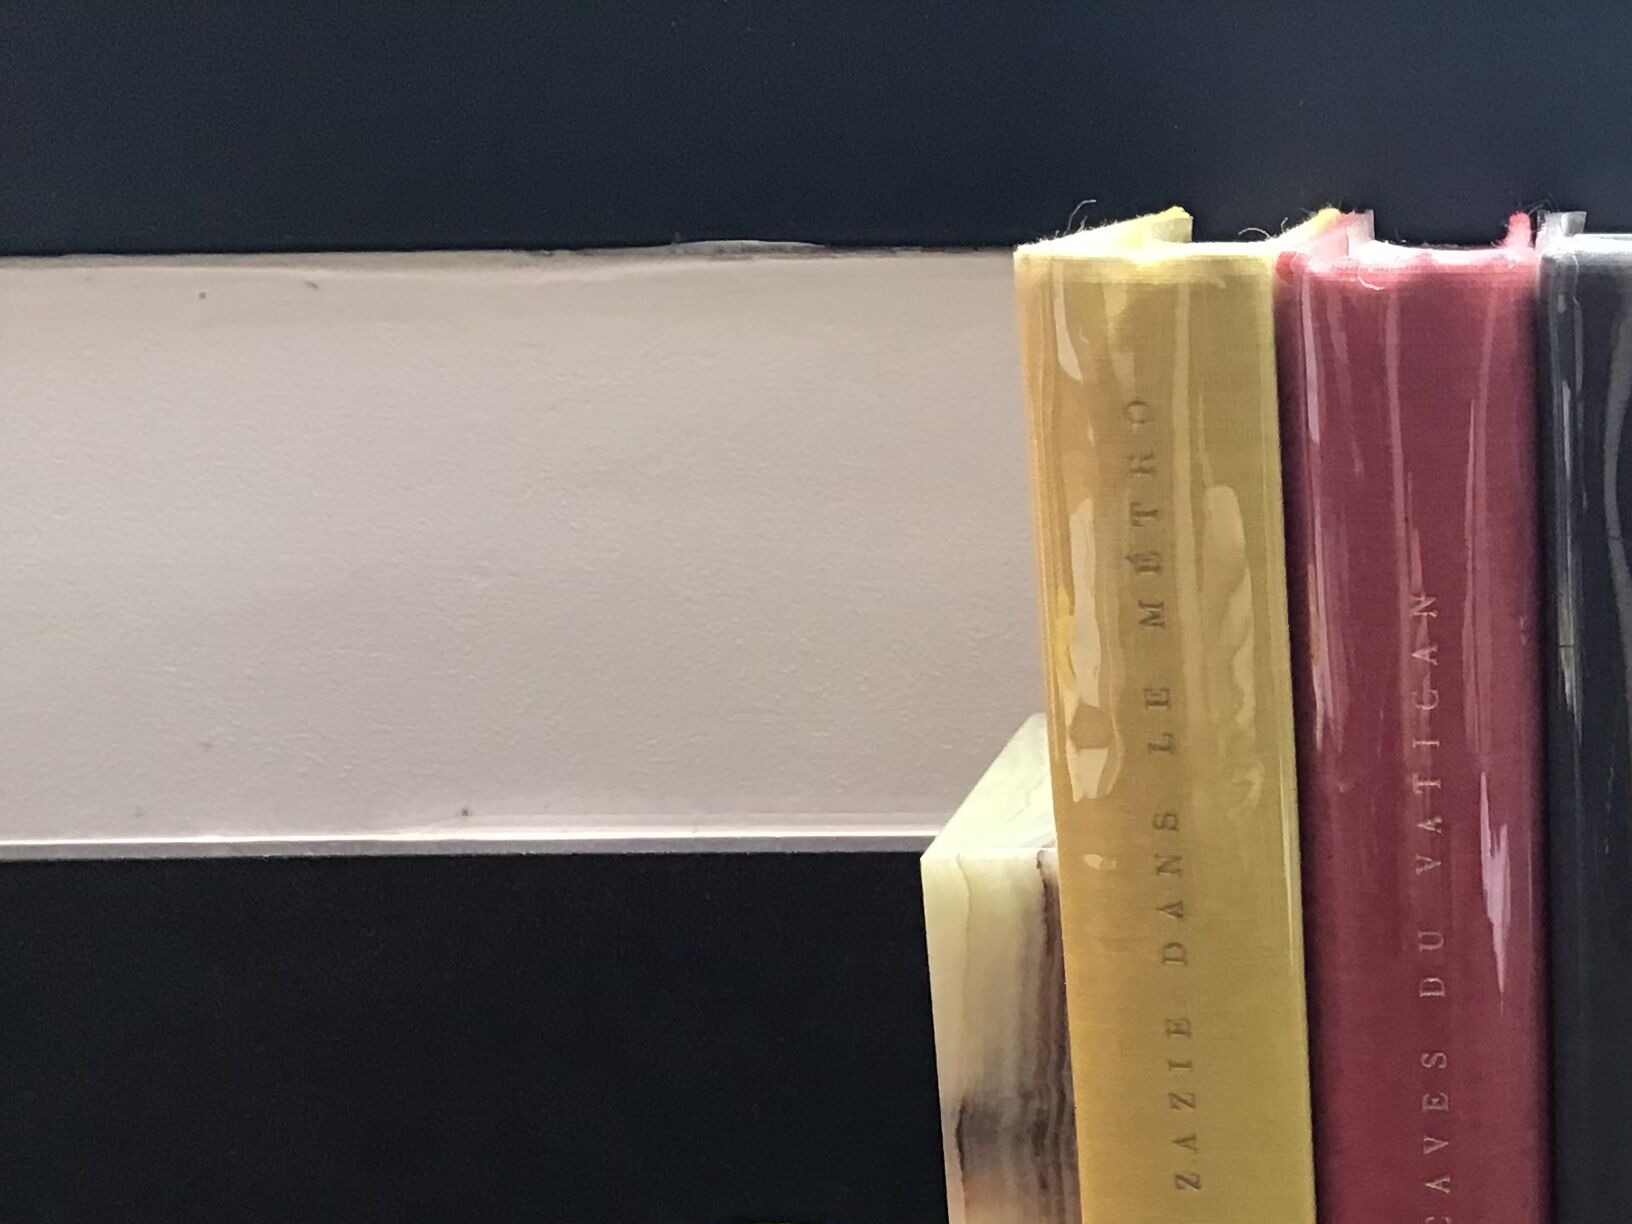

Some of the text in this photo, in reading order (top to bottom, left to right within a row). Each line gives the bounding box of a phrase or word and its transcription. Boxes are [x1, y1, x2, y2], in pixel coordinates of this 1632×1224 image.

[1125, 399, 1166, 629] MÉTRO
[1143, 687, 1176, 755] LE
[1409, 595, 1443, 876] VATICAN
[1152, 812, 1188, 967] DANS
[1417, 931, 1447, 998] DU
[1165, 1017, 1201, 1191] ZAZIE
